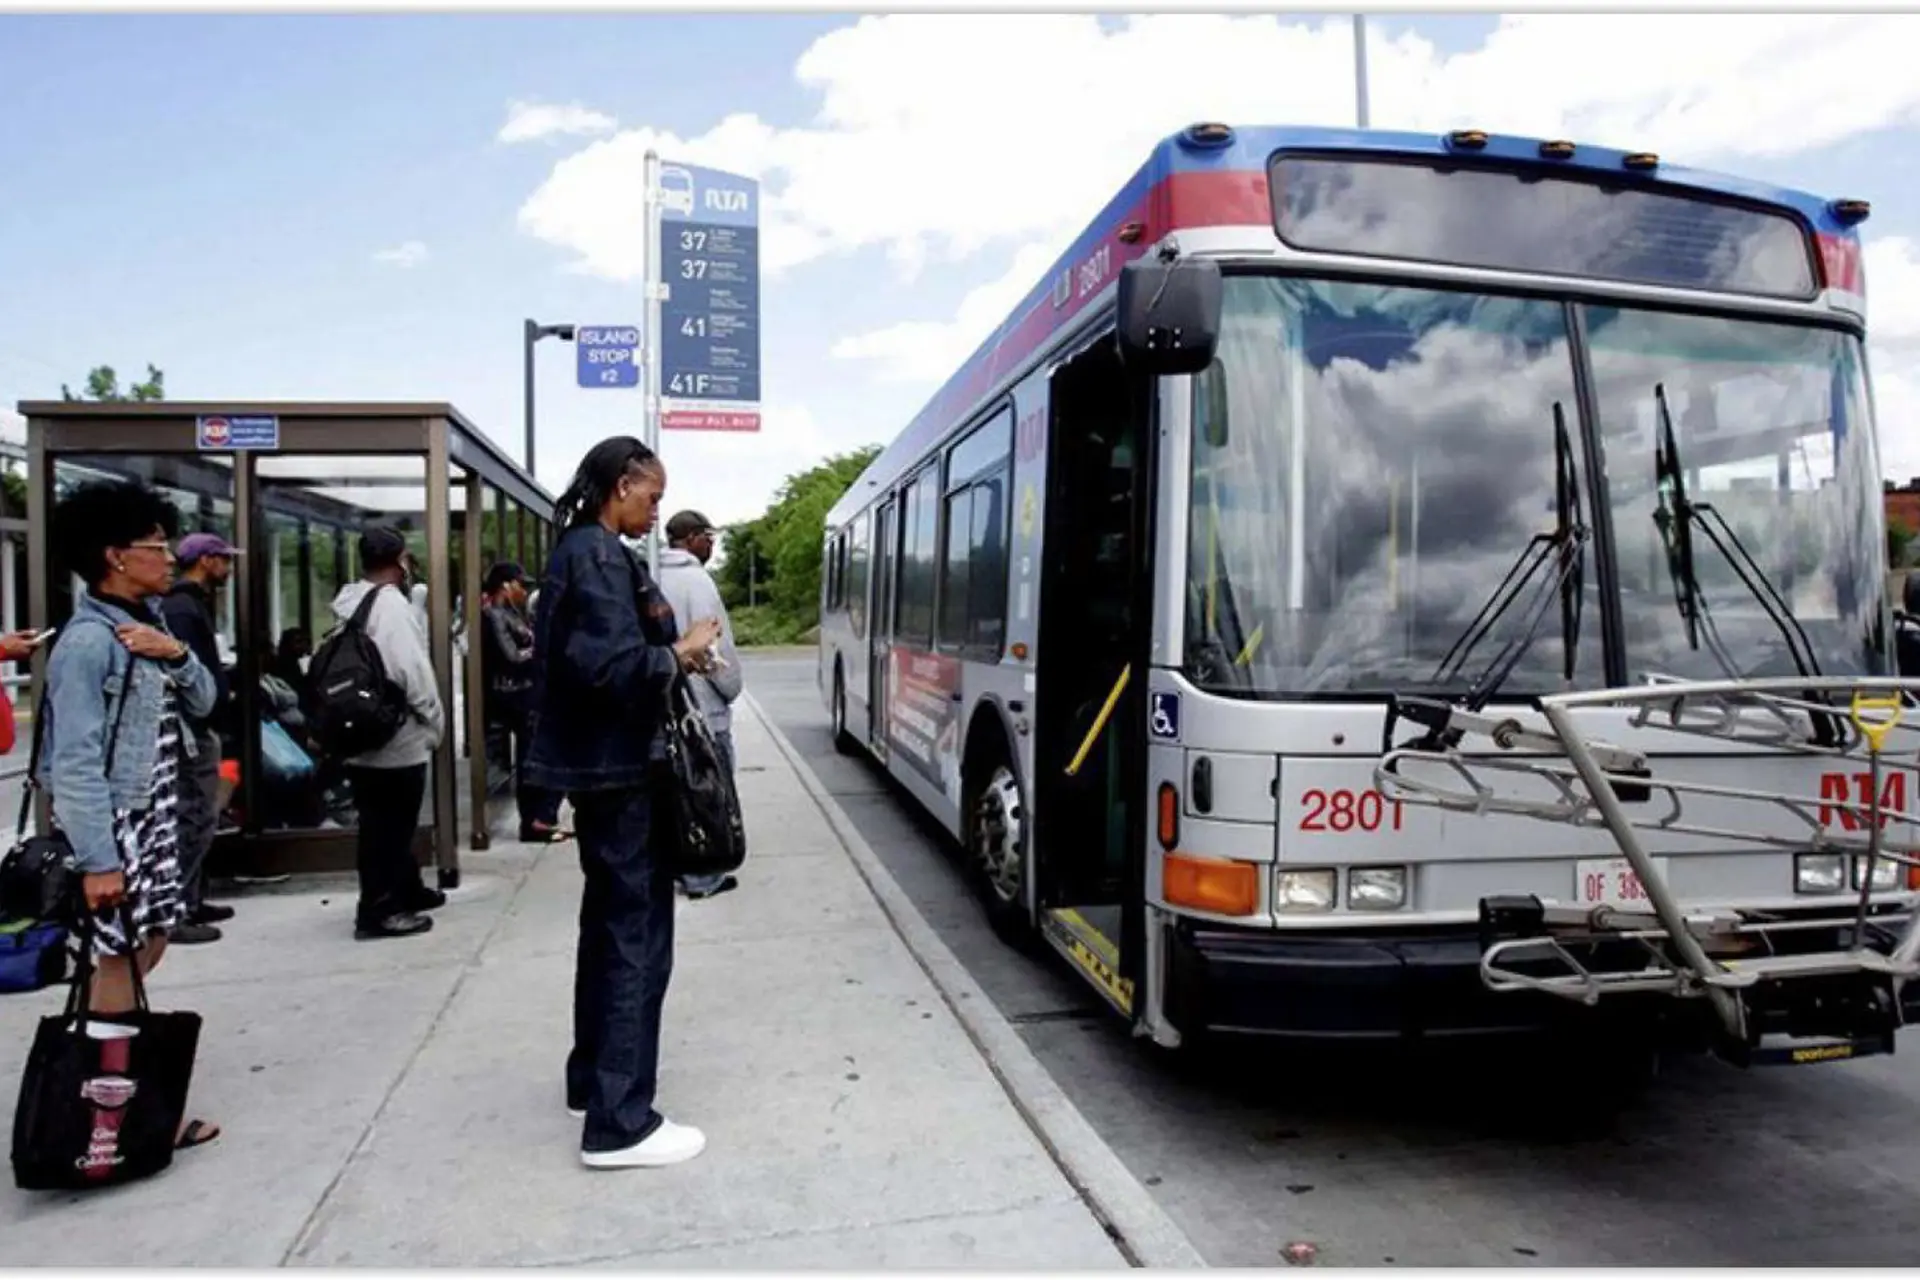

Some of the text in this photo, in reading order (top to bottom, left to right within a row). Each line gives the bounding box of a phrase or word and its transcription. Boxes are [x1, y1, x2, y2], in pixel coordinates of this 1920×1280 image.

[680, 231, 707, 251] 37
[680, 259, 708, 279] 37
[680, 317, 706, 337] 41
[580, 330, 638, 345] ISLAND
[587, 348, 630, 364] STOP
[669, 373, 709, 395] 41F
[1300, 788, 1403, 832] 2801
[1820, 771, 1906, 832] RTA
[1585, 871, 1606, 902] OF
